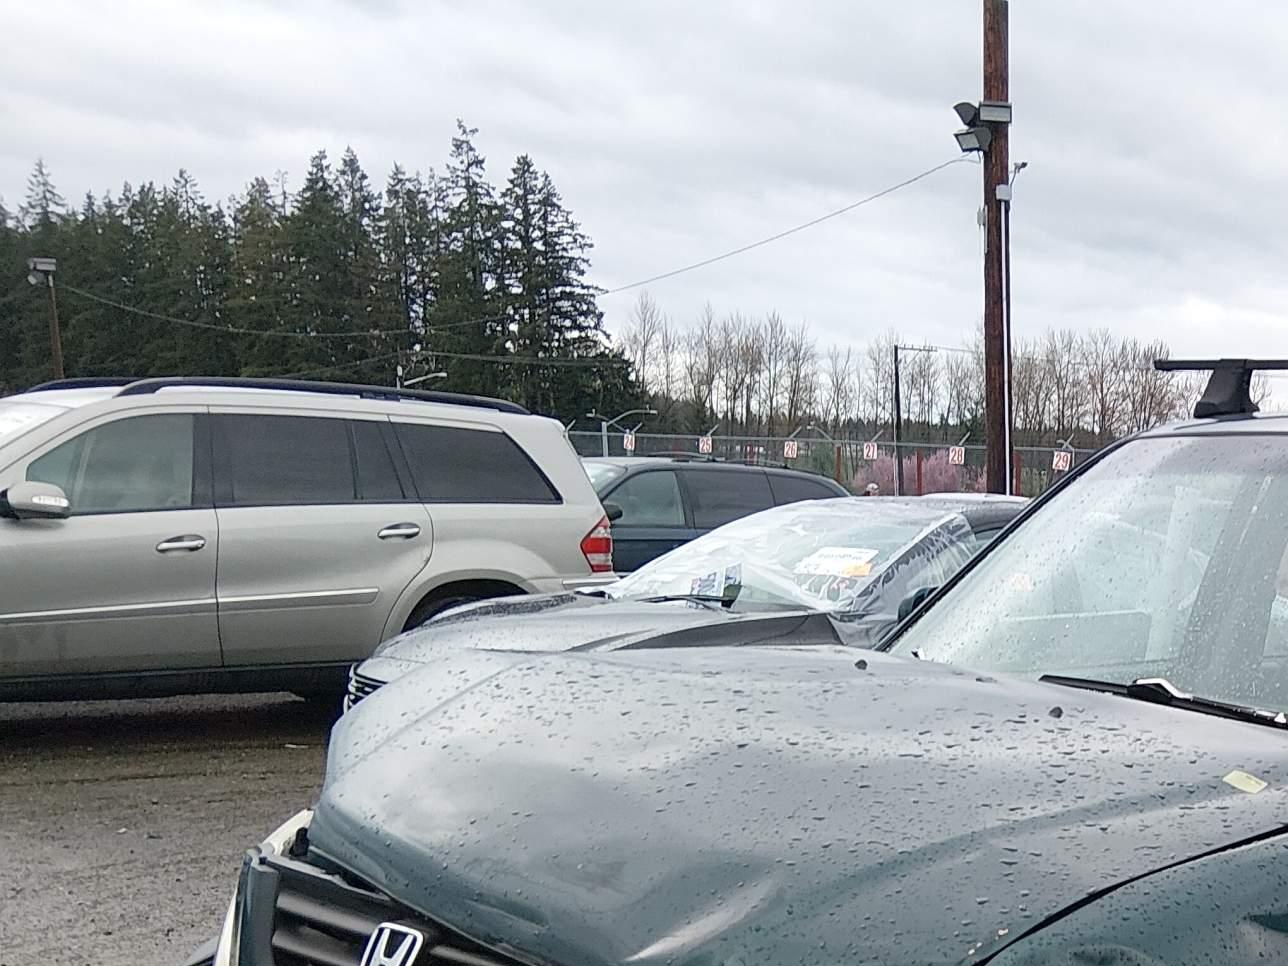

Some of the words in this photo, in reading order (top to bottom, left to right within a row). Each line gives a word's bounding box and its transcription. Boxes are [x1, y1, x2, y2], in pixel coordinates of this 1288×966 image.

[700, 438, 711, 453] 25
[785, 442, 796, 457] 26
[865, 444, 876, 459] 27
[950, 447, 963, 464] 28
[1054, 452, 1069, 469] 29
